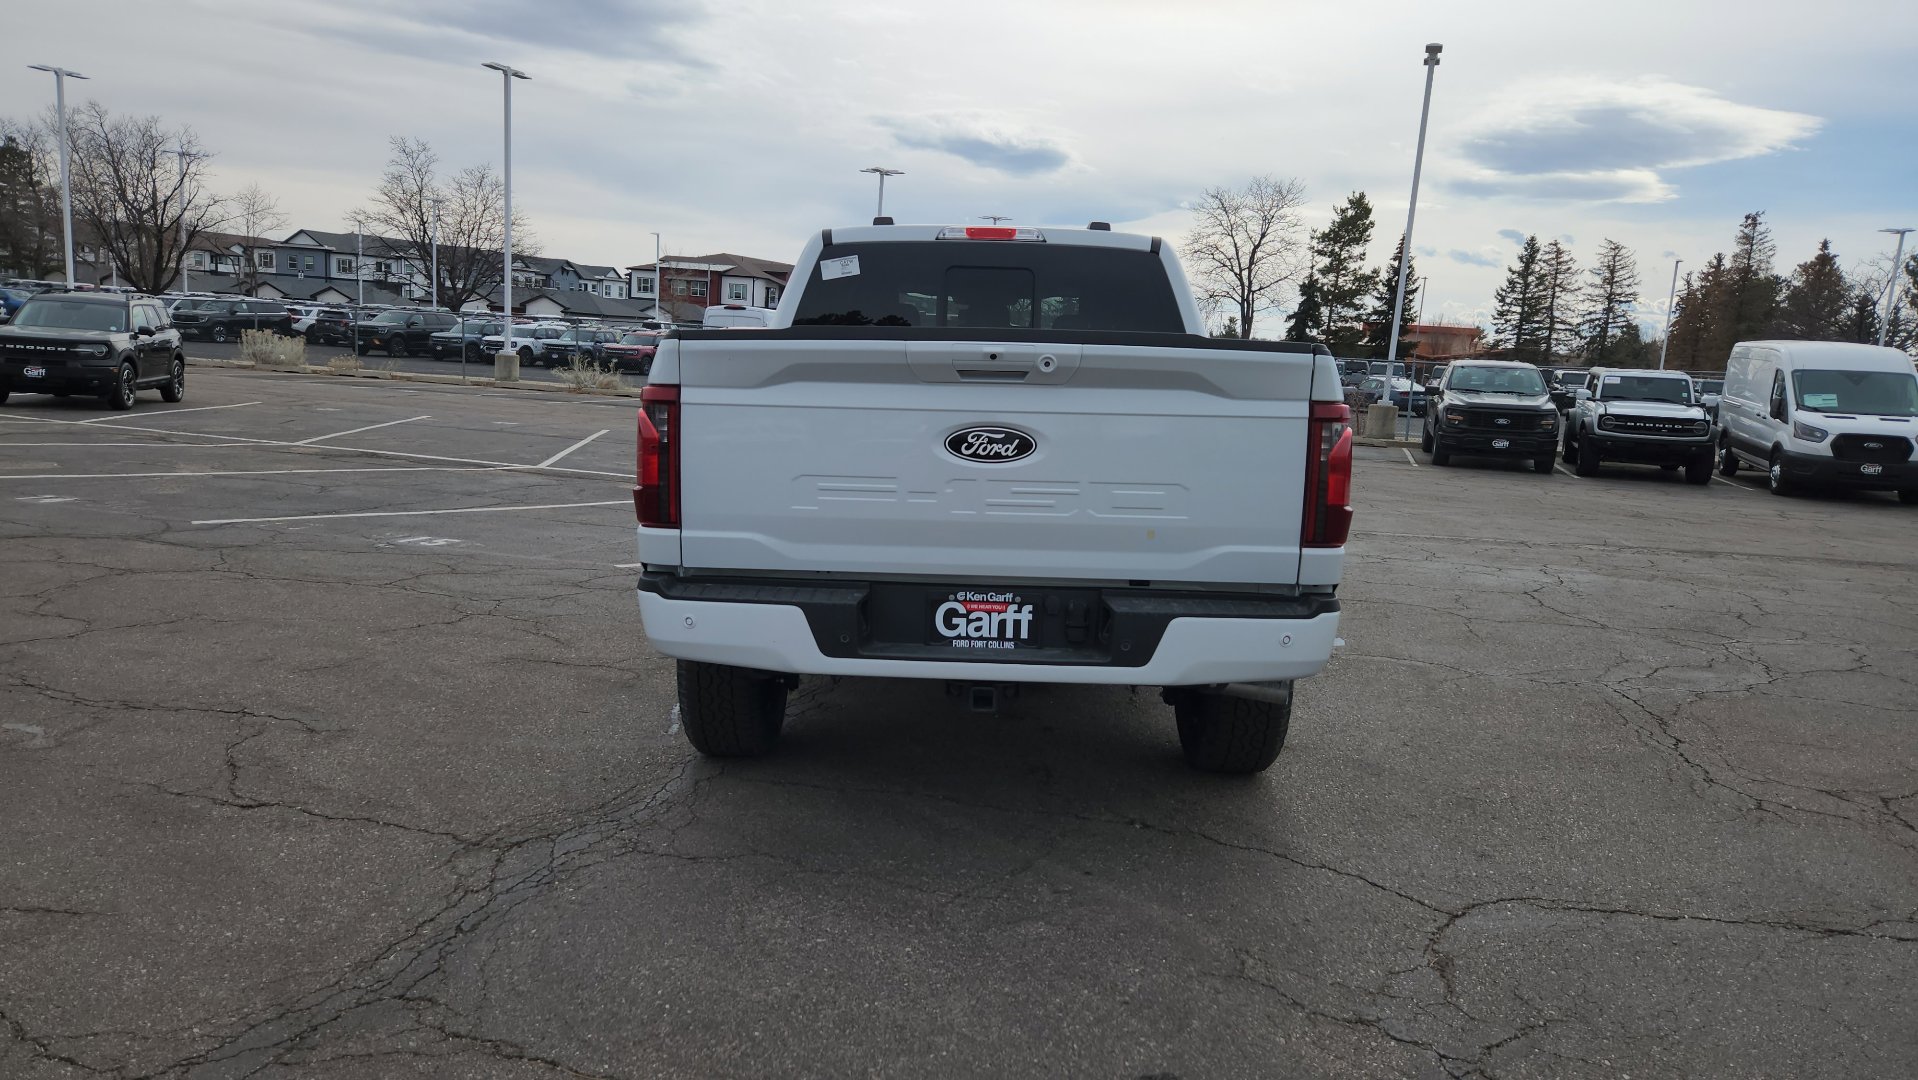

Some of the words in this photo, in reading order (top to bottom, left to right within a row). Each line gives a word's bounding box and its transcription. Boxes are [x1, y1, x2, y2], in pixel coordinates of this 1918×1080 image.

[23, 367, 46, 376] Garff
[961, 431, 1020, 457] Ford
[1860, 464, 1883, 473] Garff
[791, 474, 1190, 519] F-150
[966, 591, 986, 602] Ken
[987, 592, 1014, 603] Garff
[935, 601, 1034, 639] Garff
[952, 640, 970, 648] FORD
[971, 640, 988, 648] FORT
[988, 640, 1015, 649] COLLINS
